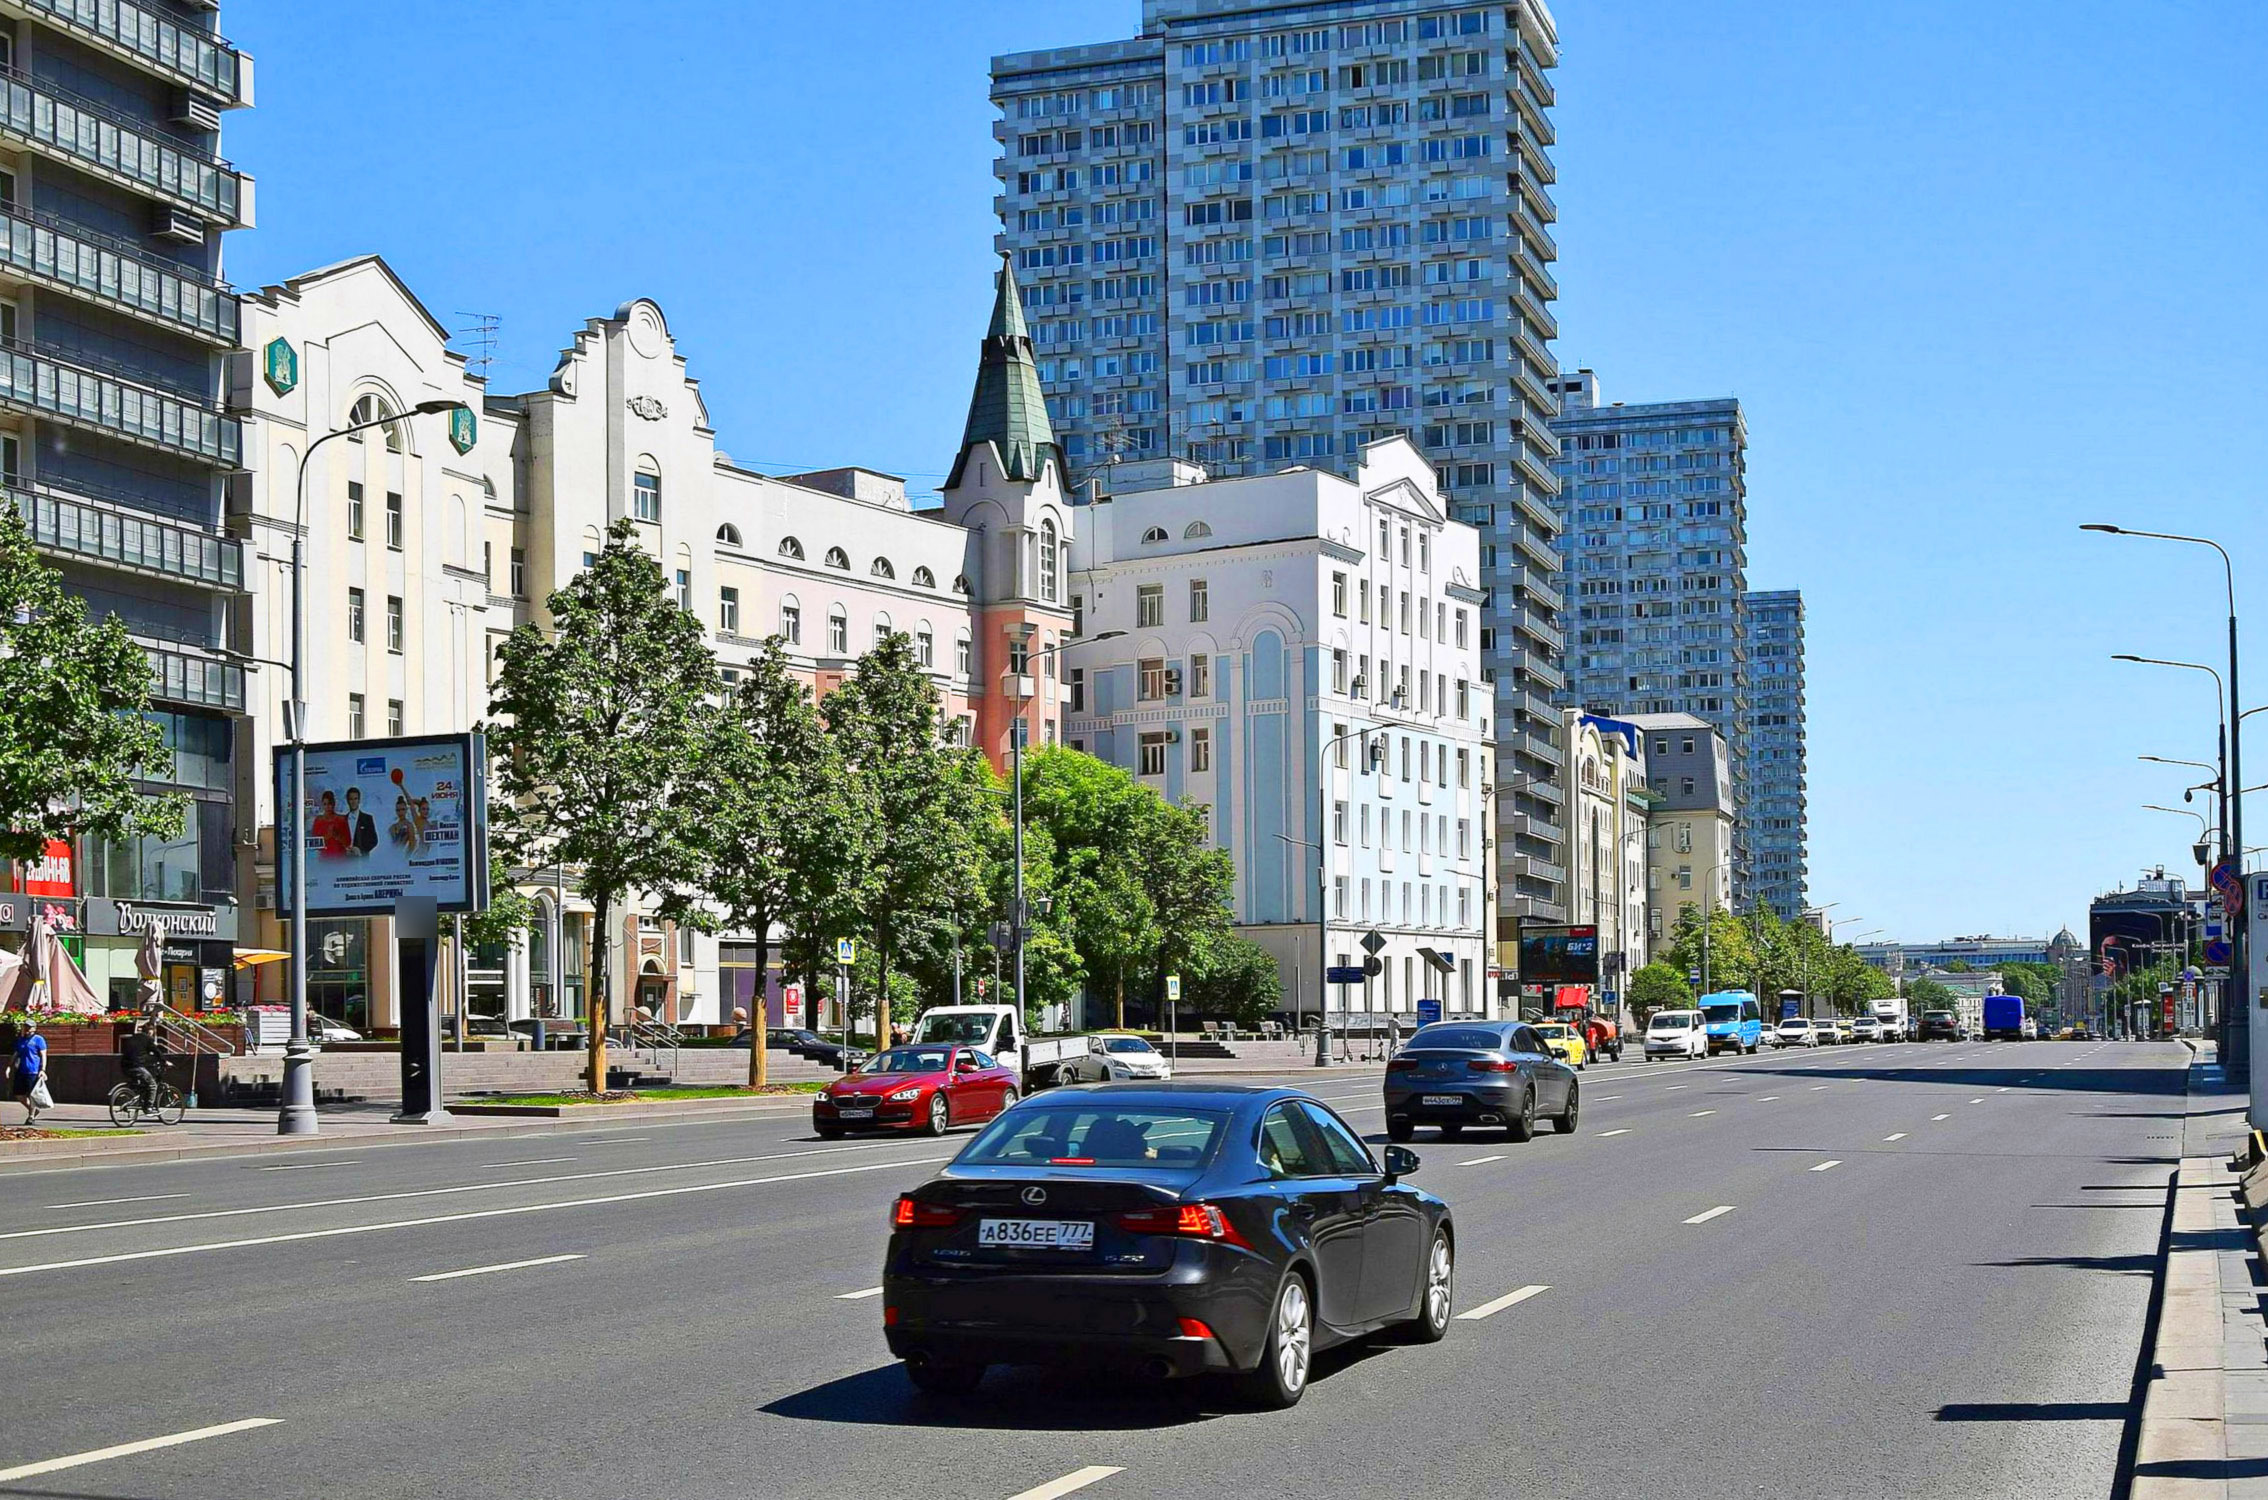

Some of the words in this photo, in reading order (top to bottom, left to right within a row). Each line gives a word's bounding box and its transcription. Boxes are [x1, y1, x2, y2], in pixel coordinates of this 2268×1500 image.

[436, 781, 452, 790] 24
[985, 1222, 1057, 1242] А836ЕЕ
[1060, 1223, 1089, 1238] 777
